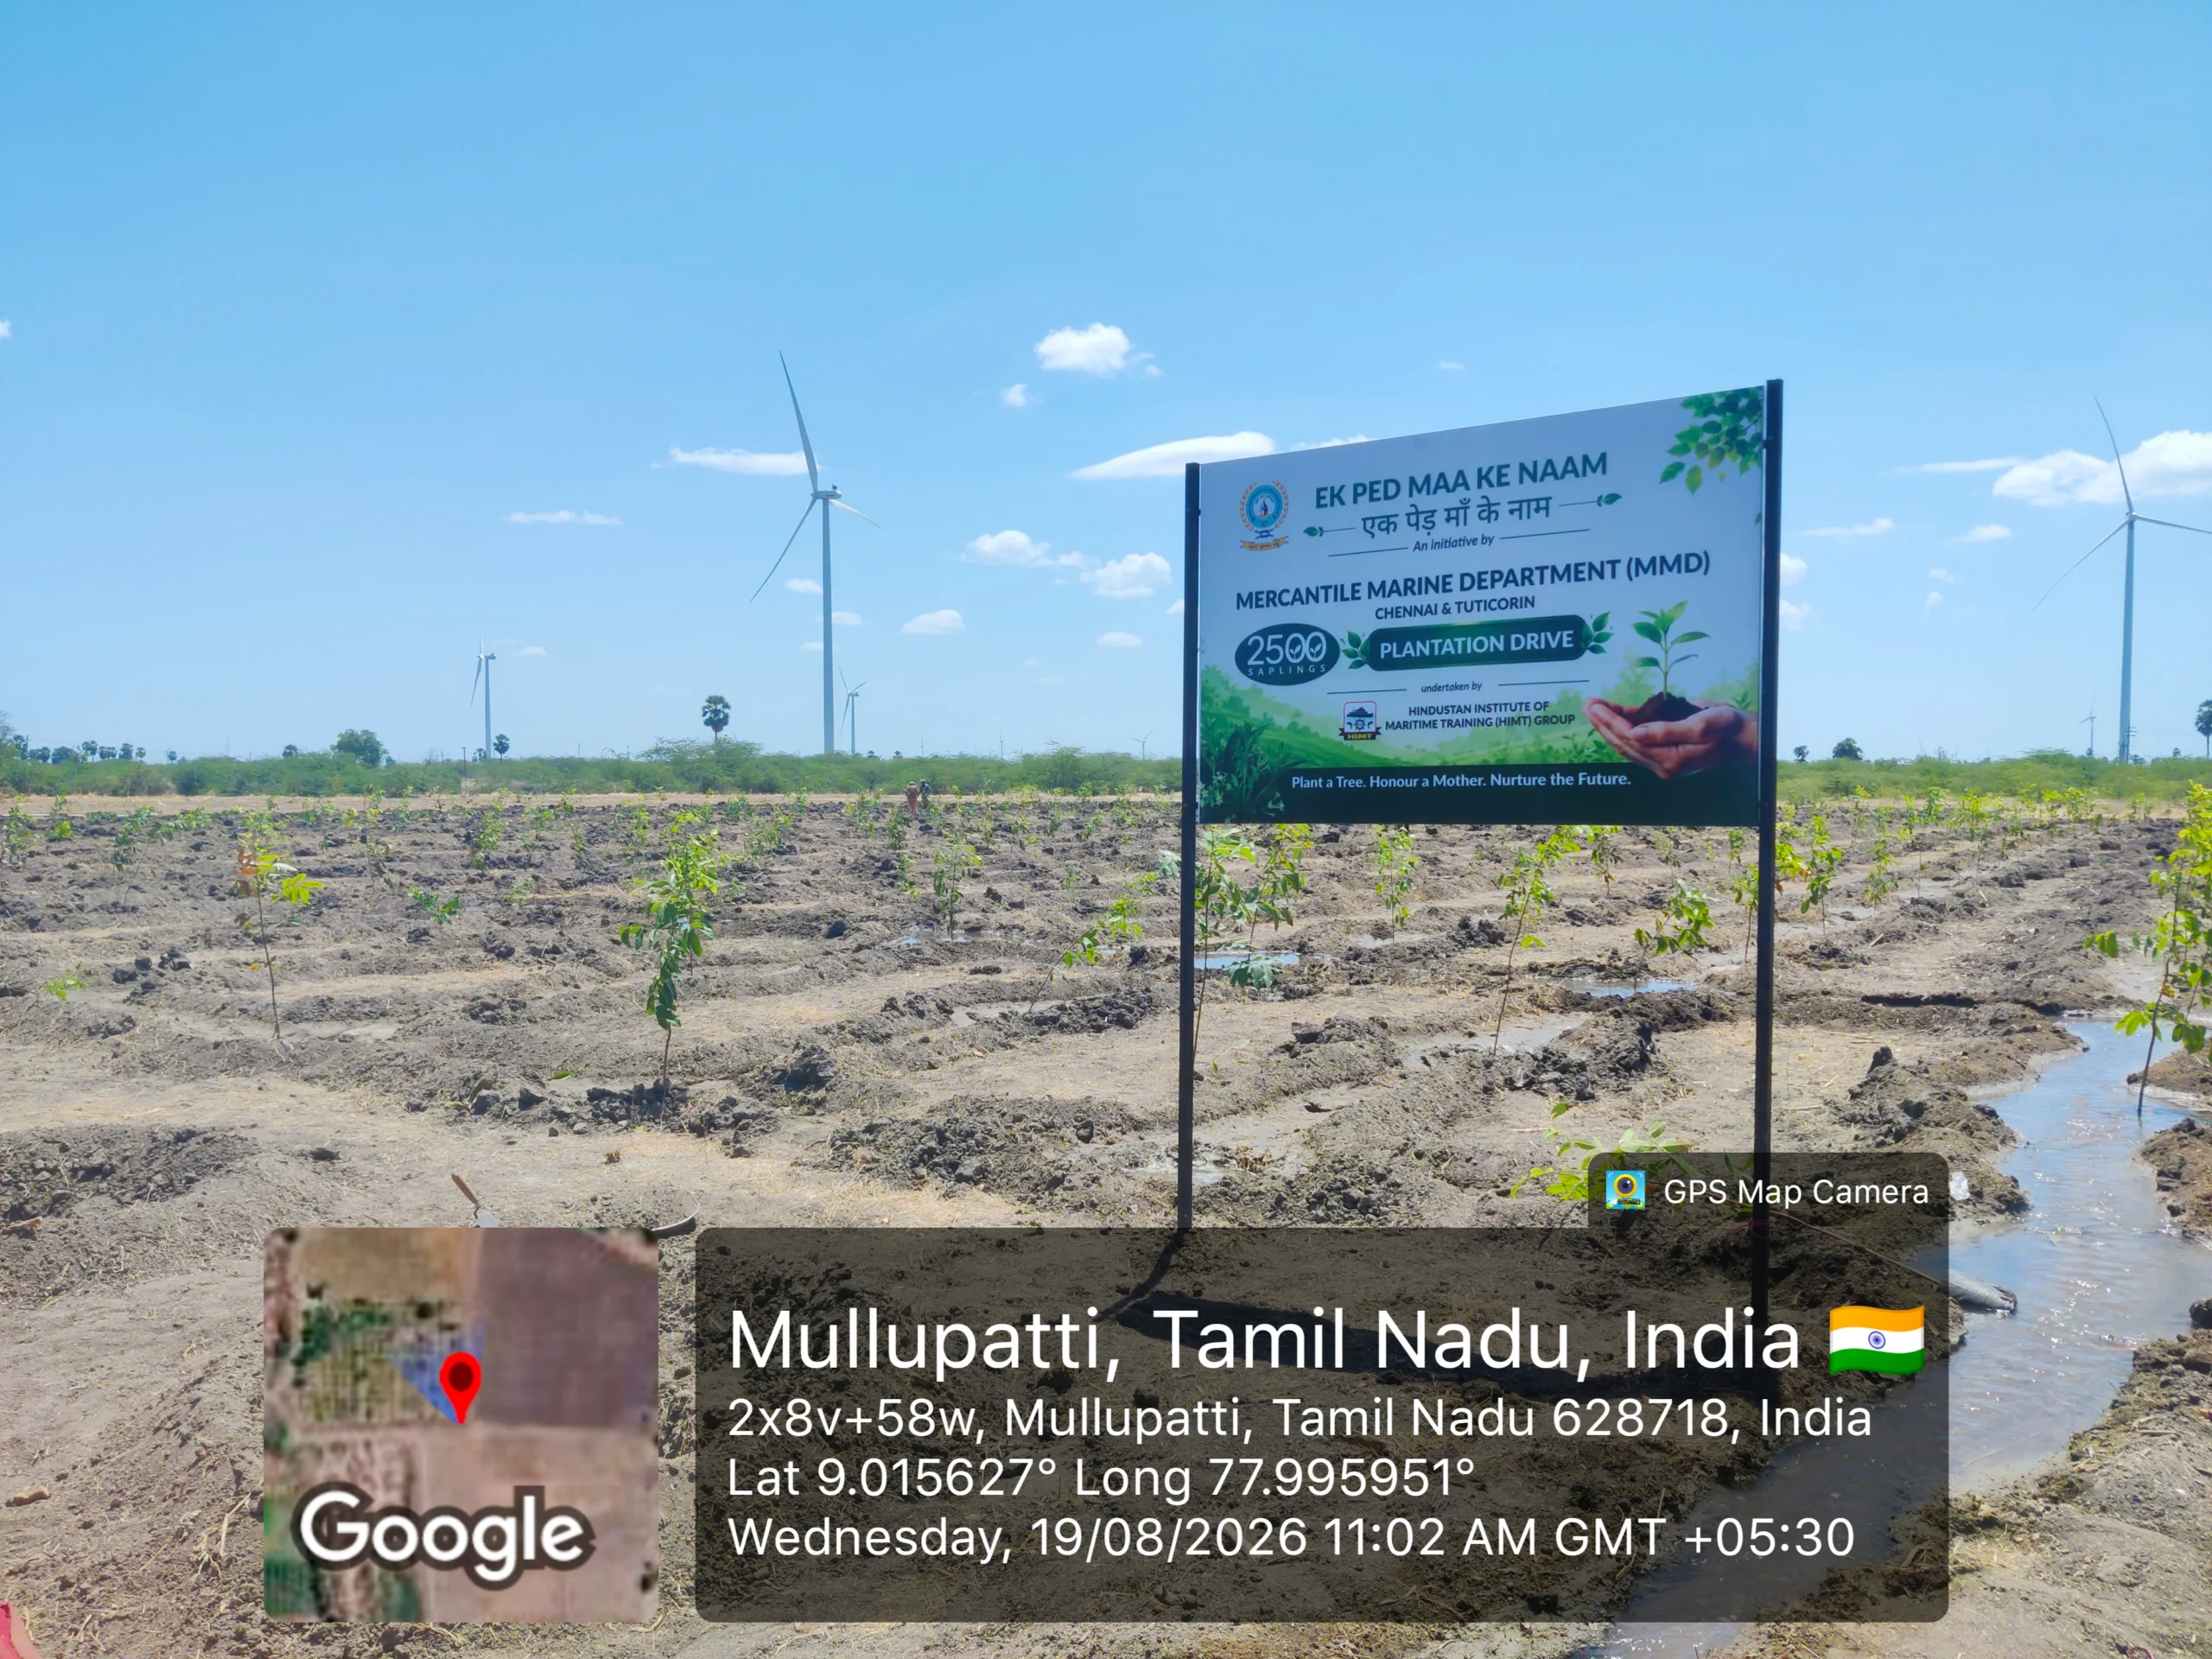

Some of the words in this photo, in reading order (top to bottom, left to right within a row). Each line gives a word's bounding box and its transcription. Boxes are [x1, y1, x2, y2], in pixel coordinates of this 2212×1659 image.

[1316, 485, 1346, 509] EK
[1352, 479, 1402, 505] PED
[1408, 469, 1471, 498] MAA
[1477, 464, 1510, 490] KE
[1518, 452, 1607, 485] NAAM
[1361, 514, 1399, 538] एक
[1405, 504, 1437, 536] पेड़
[1444, 498, 1471, 527] माँ
[1477, 495, 1501, 524] के
[1507, 496, 1553, 520] नाम
[1413, 540, 1428, 552] An
[1430, 534, 1478, 550] initiative
[1480, 533, 1495, 546] by
[1236, 582, 1362, 610] MERCANTILE
[1367, 574, 1453, 600] MARINE
[1459, 559, 1621, 592] DEPARTMENT
[1626, 550, 1710, 582] (MMD)
[1375, 603, 1438, 620] CHENNAI
[1441, 601, 1452, 615] &
[1454, 595, 1535, 615] TUTICORIN
[1247, 631, 1327, 665] 2500
[1380, 634, 1504, 659] PLANTATION
[1510, 630, 1573, 652] DRIVE
[1248, 664, 1326, 677] SAPLINGS
[1421, 682, 1469, 693] undertaken
[1471, 681, 1482, 692] by
[1408, 704, 1471, 716] HINDUSTAN
[1474, 702, 1531, 714] INSTITUTE
[1534, 701, 1549, 711] OF
[1385, 719, 1438, 731] MARITIME
[1440, 716, 1493, 729] TRAINING
[1495, 715, 1532, 728] (HIMT)
[1534, 714, 1575, 725] GROUP
[1292, 776, 1323, 788] Plant
[1325, 779, 1333, 788] a
[1336, 776, 1366, 788] Tree.
[1370, 775, 1420, 788] Honour
[1421, 778, 1429, 787] a
[1433, 774, 1486, 787] Mother.
[1490, 773, 1547, 786] Nurture
[1550, 772, 1574, 785] the
[1578, 772, 1631, 785] Future.
